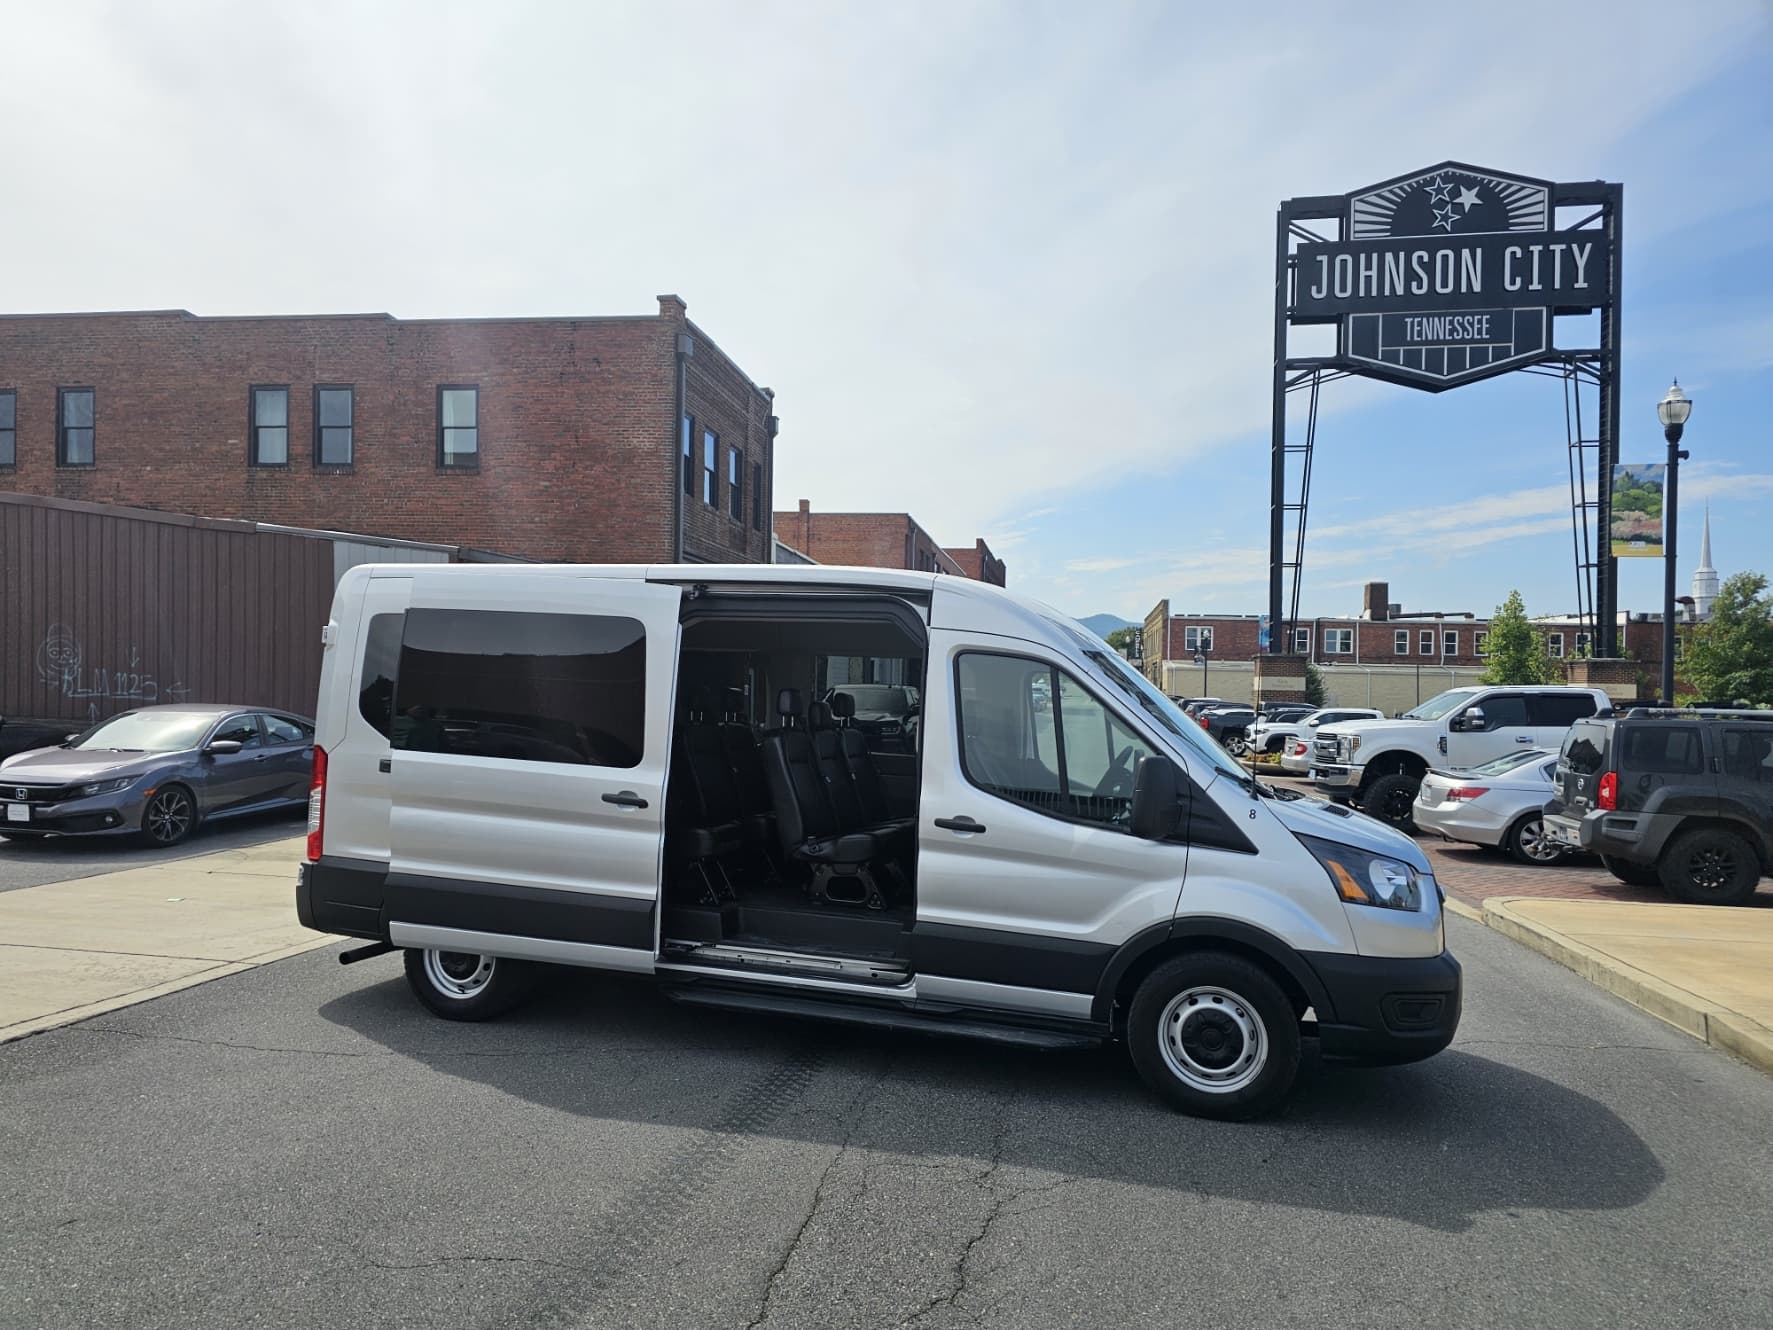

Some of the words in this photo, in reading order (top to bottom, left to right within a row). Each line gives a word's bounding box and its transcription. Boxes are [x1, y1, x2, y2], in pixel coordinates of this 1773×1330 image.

[1310, 247, 1482, 300] JOHNSON
[1503, 242, 1593, 292] CITY
[1404, 314, 1491, 342] TENNESSEE
[1248, 808, 1257, 820] 8
